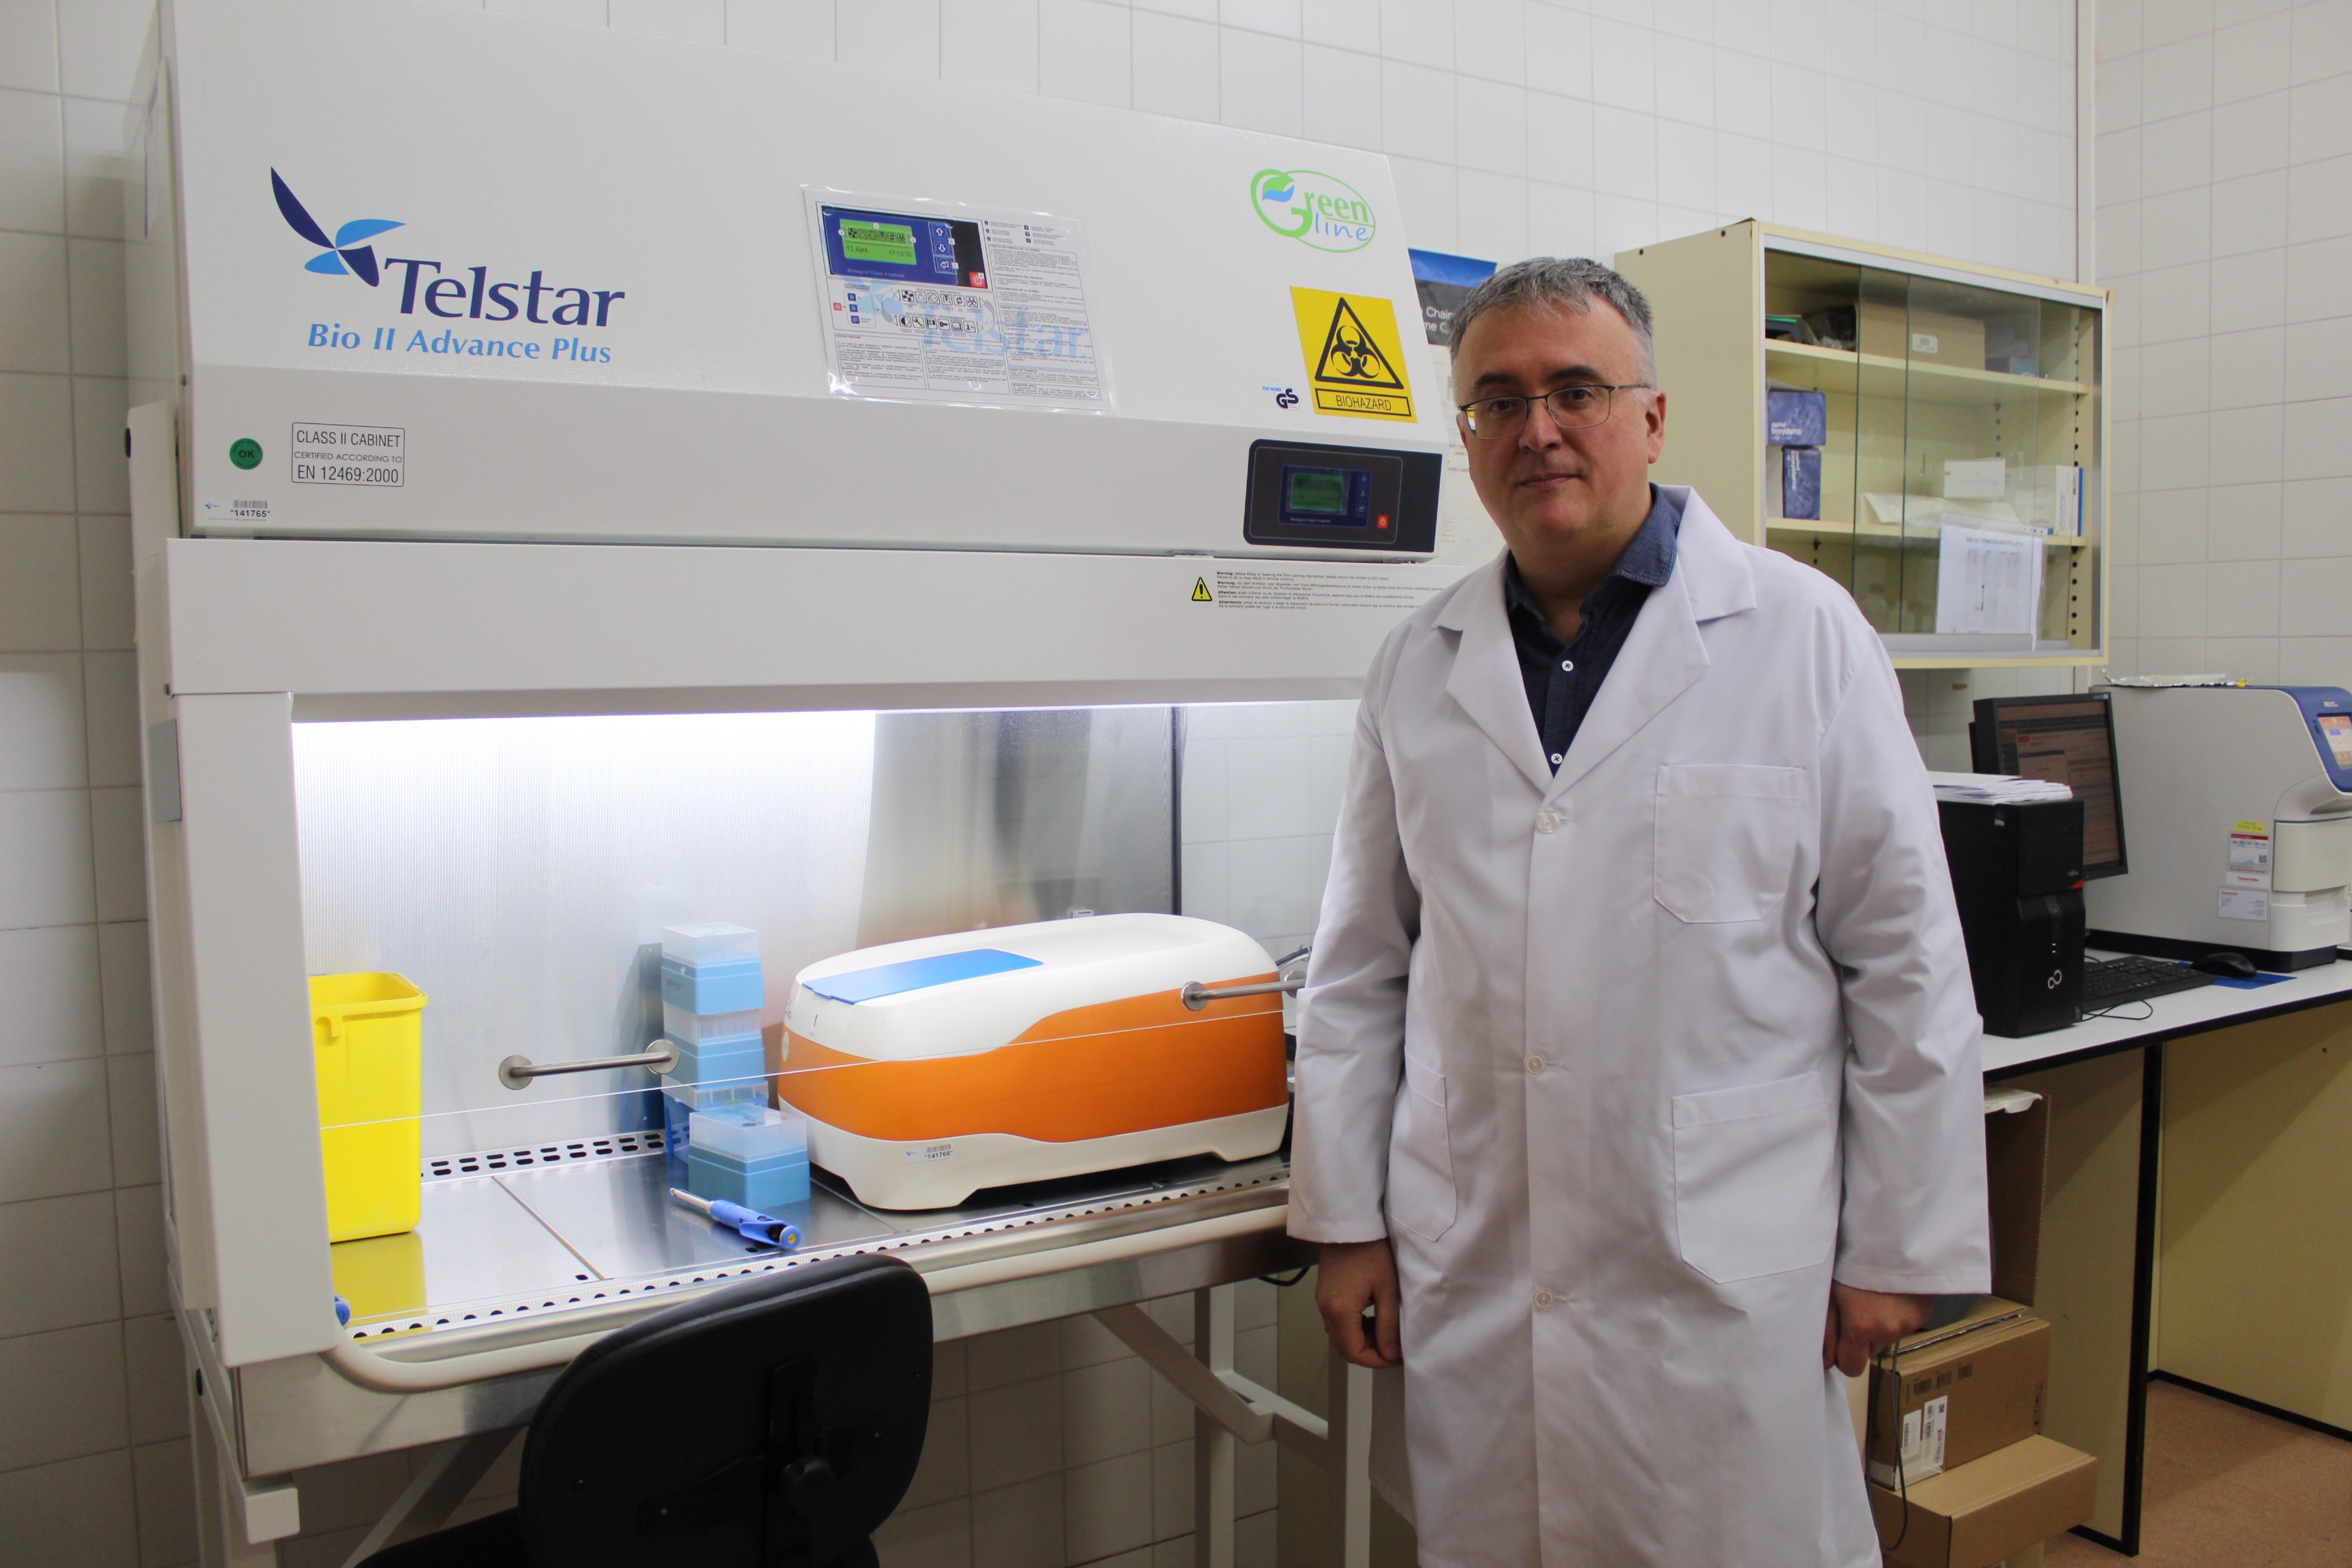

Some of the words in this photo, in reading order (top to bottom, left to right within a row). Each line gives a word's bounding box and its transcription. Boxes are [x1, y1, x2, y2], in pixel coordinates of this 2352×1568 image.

[1251, 169, 1369, 238] Green
[1315, 213, 1369, 241] line
[384, 258, 625, 327] Telstar
[308, 323, 361, 349] Bio
[374, 327, 395, 351] II
[406, 329, 540, 359] Advance
[552, 338, 611, 363] Plus
[1276, 389, 1298, 408] GS
[1336, 395, 1391, 411] BIOHAZARD
[297, 430, 336, 444] CLASS
[340, 432, 346, 445] II
[350, 433, 400, 447] CABINET
[1771, 427, 1801, 436] biosystems
[239, 450, 255, 458] OK
[294, 452, 333, 460] CERTIFIED
[336, 454, 389, 463] ACCORDING
[298, 465, 315, 479] EN
[321, 466, 399, 483] 12469:2000
